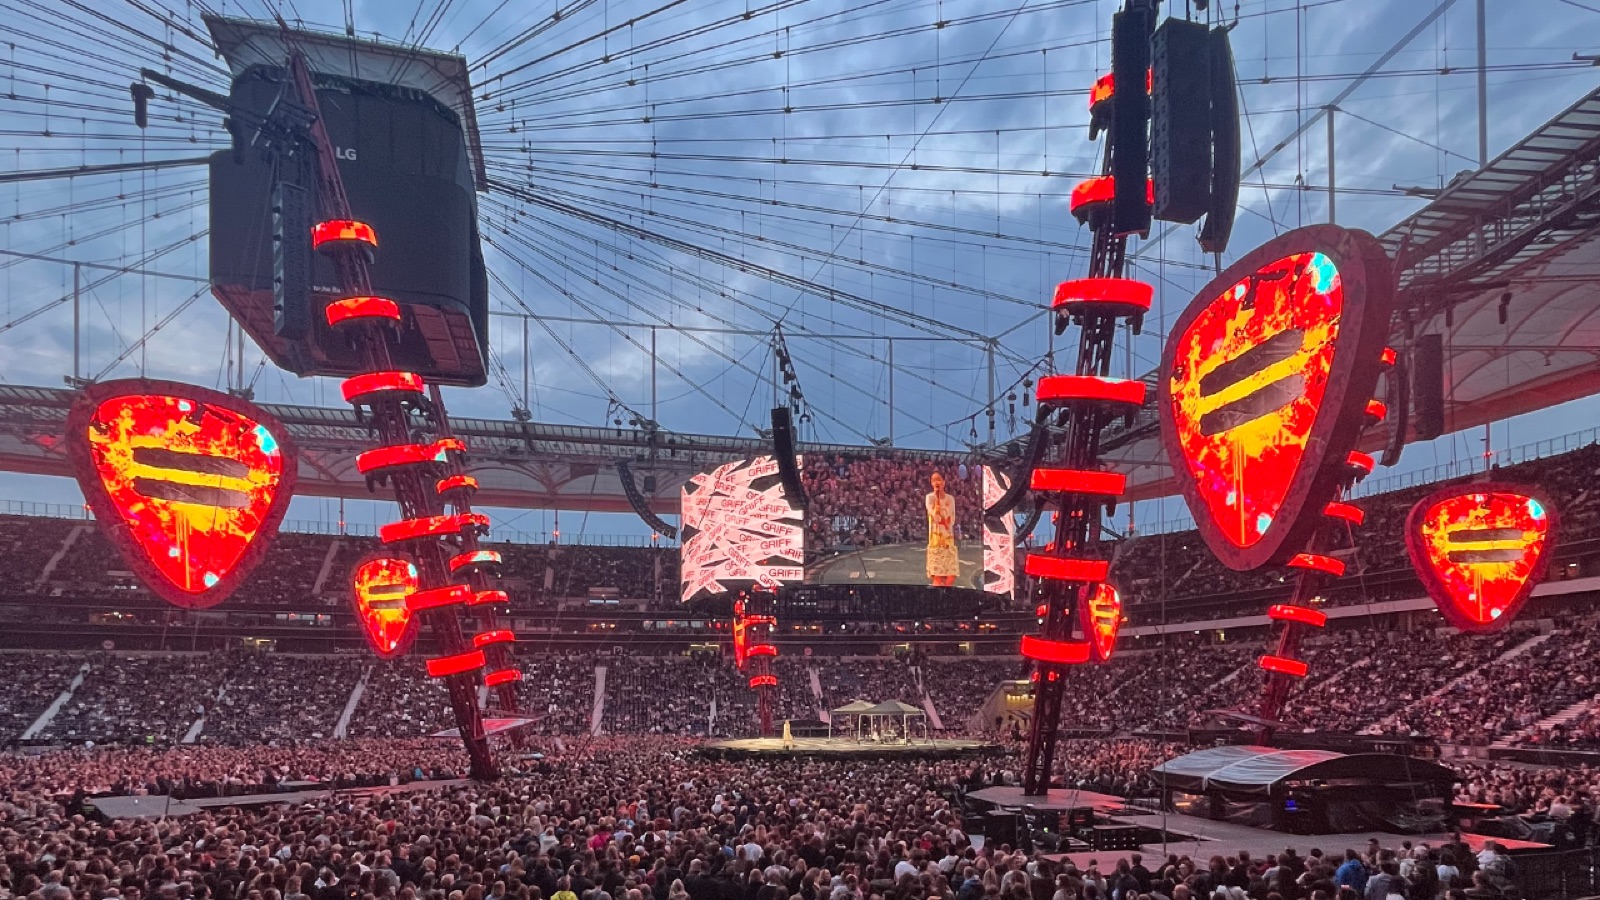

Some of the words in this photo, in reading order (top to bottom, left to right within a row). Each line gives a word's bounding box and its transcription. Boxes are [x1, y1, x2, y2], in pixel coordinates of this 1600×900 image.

[336, 146, 356, 160] LG
[748, 463, 777, 477] GRIFF
[761, 522, 793, 535] GRIFF
[761, 538, 792, 549] GRIFF
[769, 568, 802, 578] GRIFF
